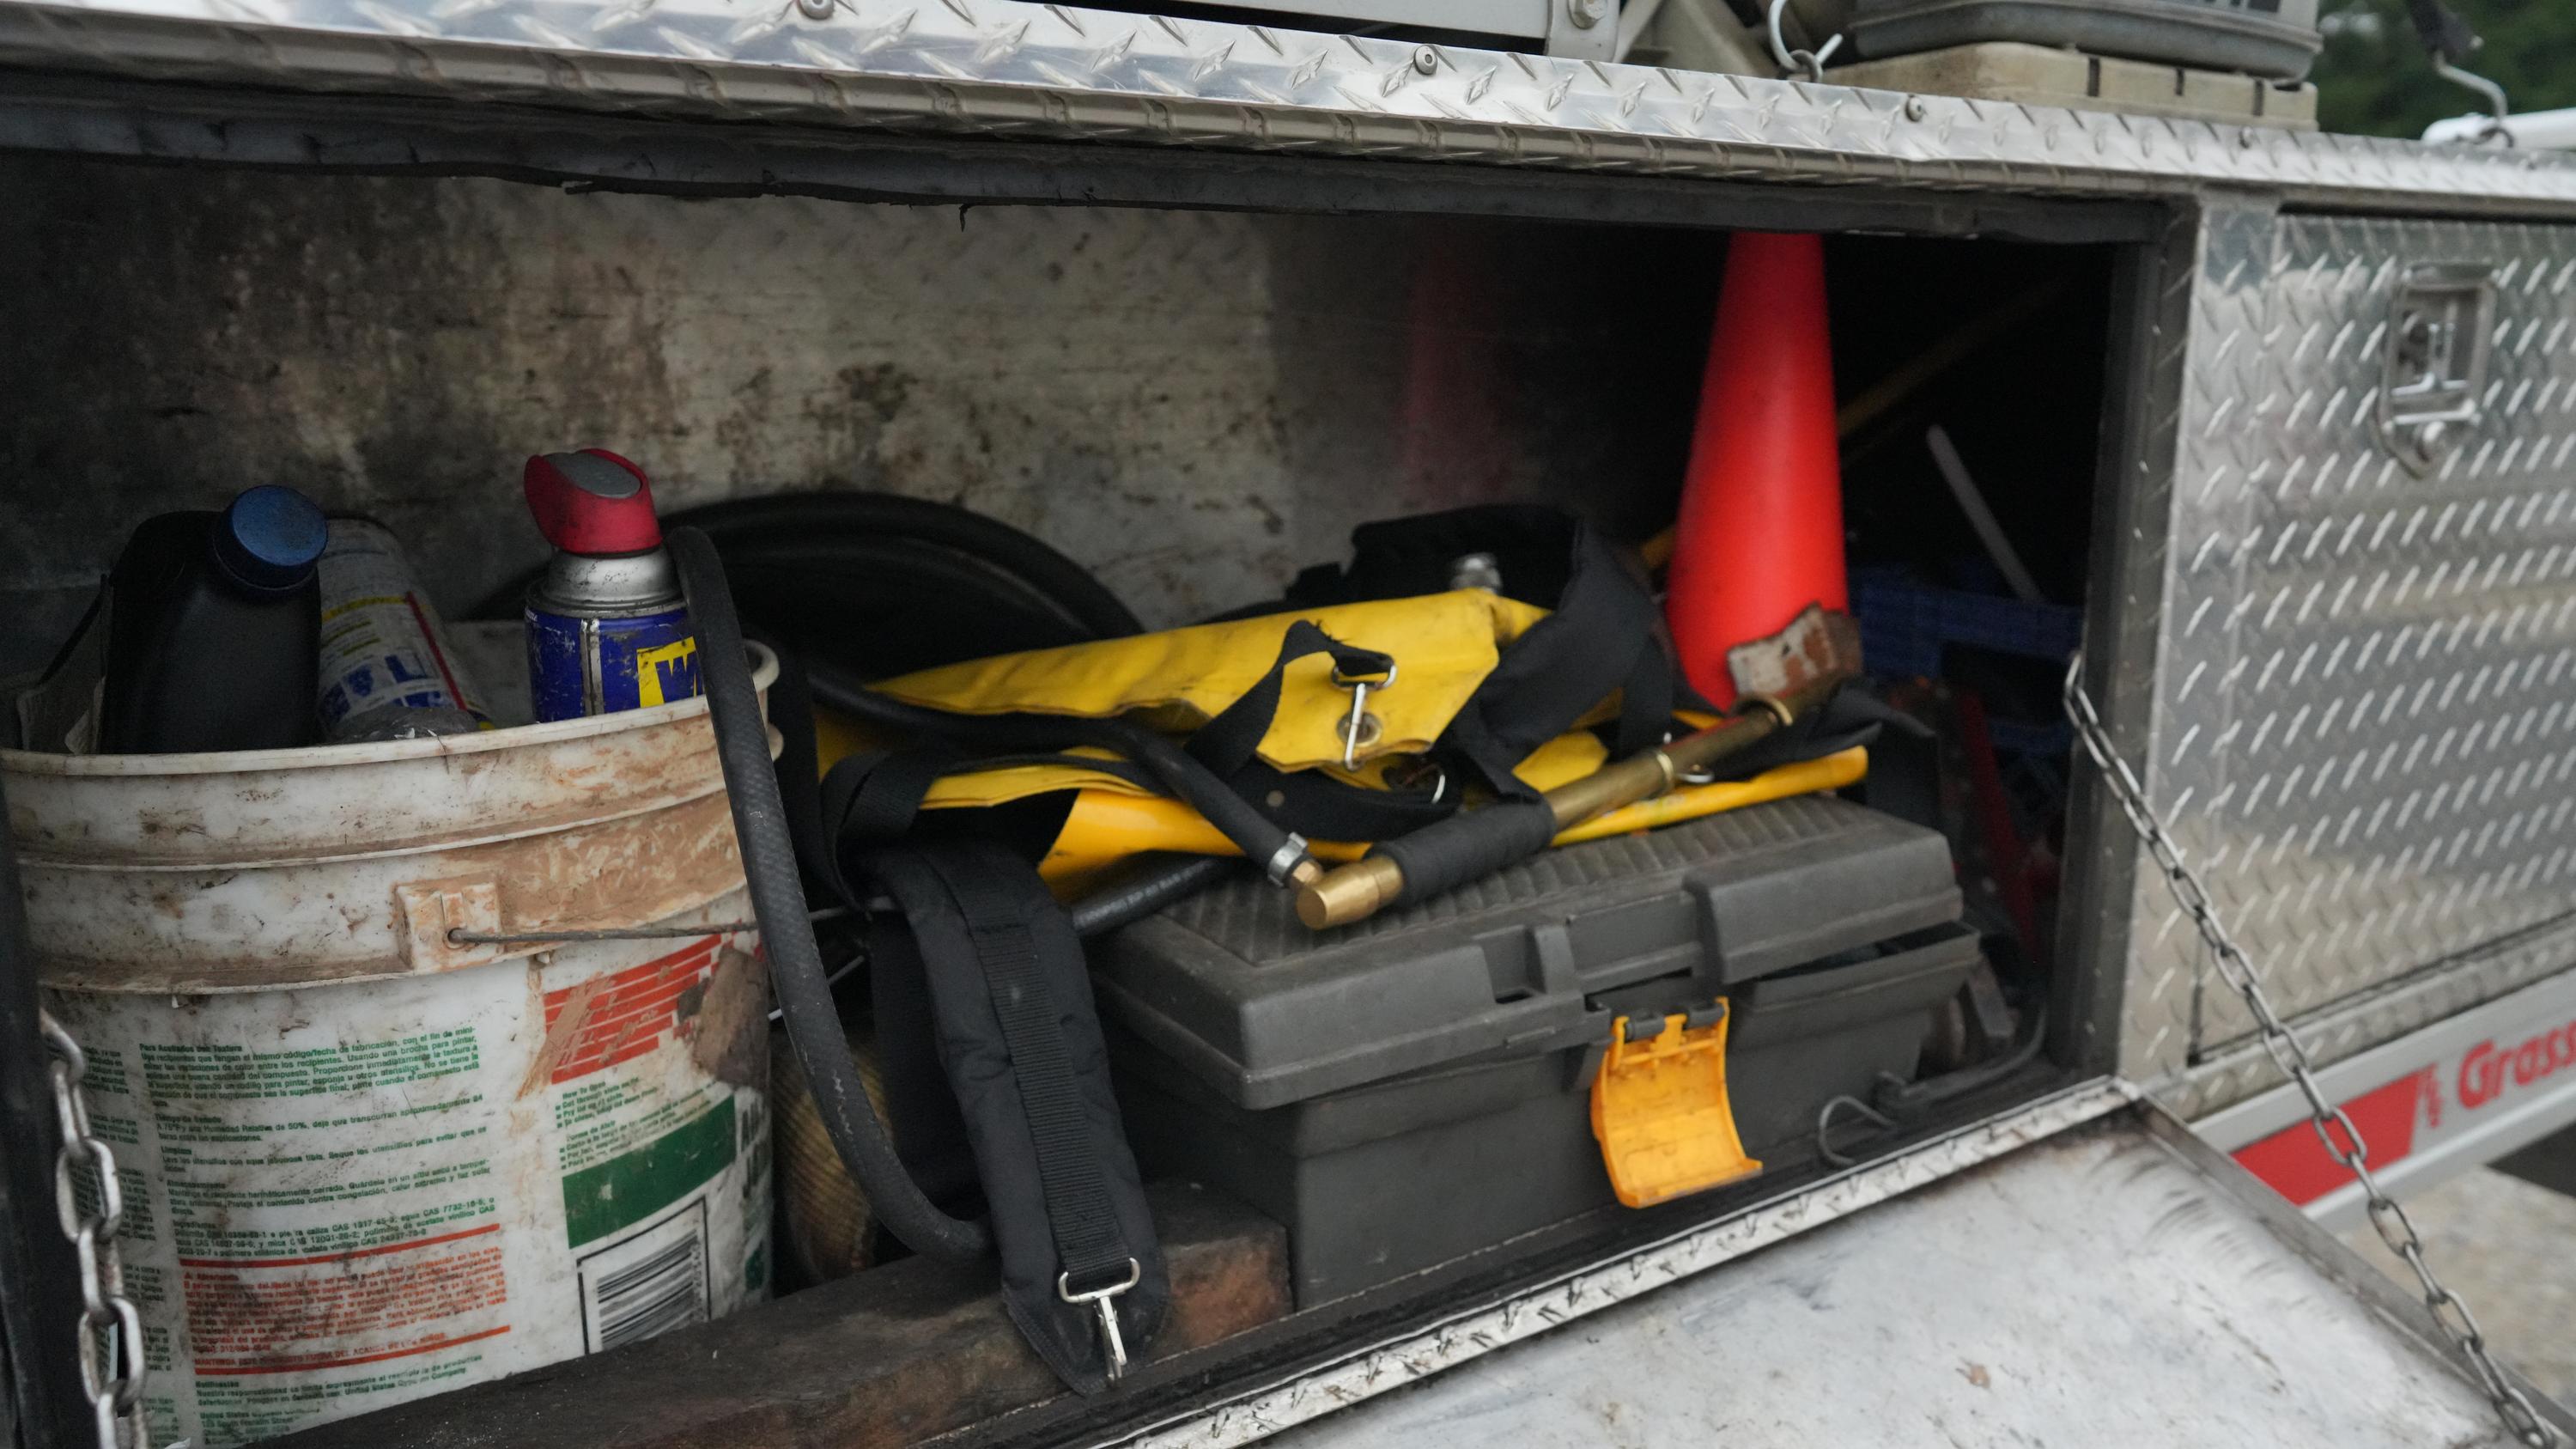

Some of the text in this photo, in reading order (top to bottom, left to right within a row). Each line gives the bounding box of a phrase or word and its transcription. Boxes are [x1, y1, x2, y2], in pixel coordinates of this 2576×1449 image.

[252, 1053, 282, 1062] mismo
[347, 1053, 380, 1062] Usando
[382, 1050, 398, 1058] una
[400, 1044, 429, 1055] brocha
[431, 1040, 450, 1050] para
[433, 1050, 441, 1059] la
[442, 1045, 473, 1057] textura
[264, 1081, 283, 1090] para
[312, 1075, 345, 1086] esponja
[355, 1070, 379, 1080] otros
[423, 1061, 436, 1069] No
[450, 1055, 471, 1065] tiene
[331, 1118, 348, 1128] que
[279, 1230, 304, 1239] piera
[331, 1223, 350, 1233] CAS
[423, 1207, 440, 1218] CAS
[361, 1236, 379, 1246] CAS
